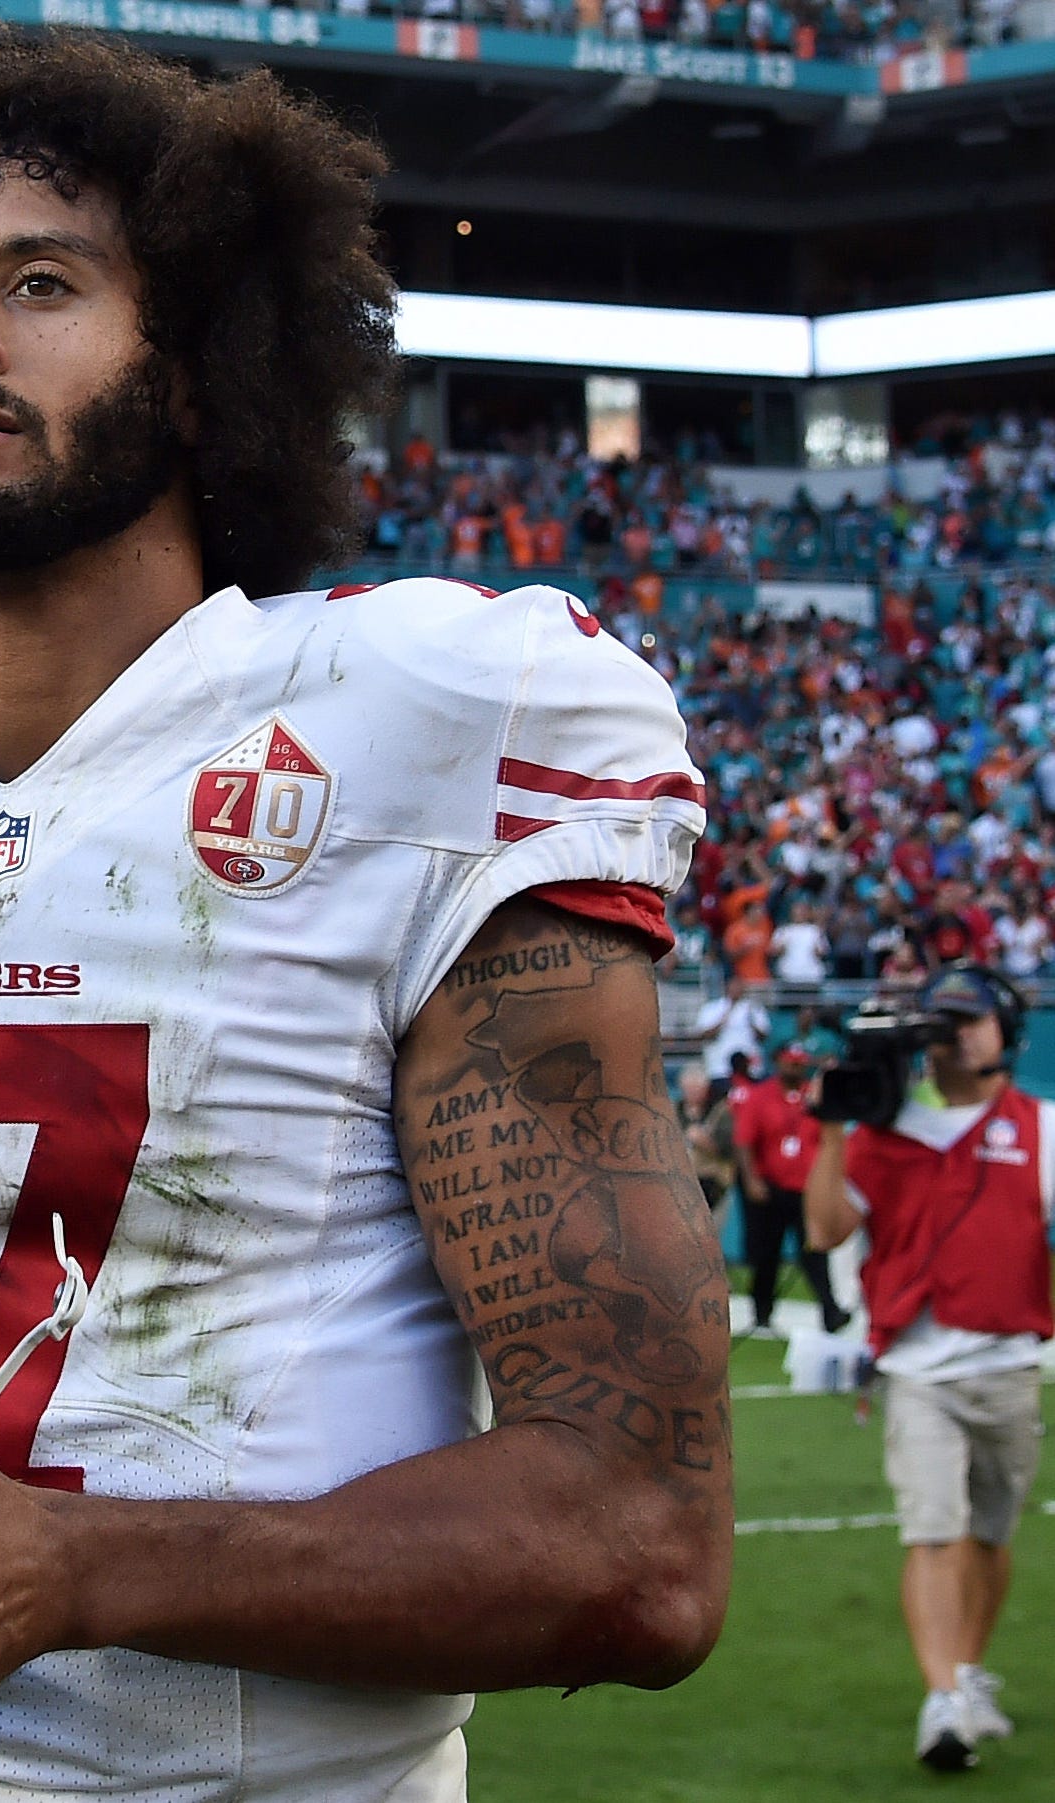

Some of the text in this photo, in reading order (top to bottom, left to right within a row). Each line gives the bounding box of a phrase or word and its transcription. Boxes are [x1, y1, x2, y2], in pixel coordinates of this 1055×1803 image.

[283, 759, 300, 770] 16
[213, 837, 286, 858] YEARS
[452, 942, 572, 988] THOUGH
[426, 1083, 511, 1129] ARMY
[428, 1127, 476, 1164] ME
[490, 1118, 541, 1148] MY
[419, 1152, 564, 1205] WILL NOT
[444, 1192, 555, 1244] AFRAID
[488, 1229, 540, 1262] AM
[474, 1267, 555, 1305] WILL
[467, 1296, 587, 1345] NFIDENT
